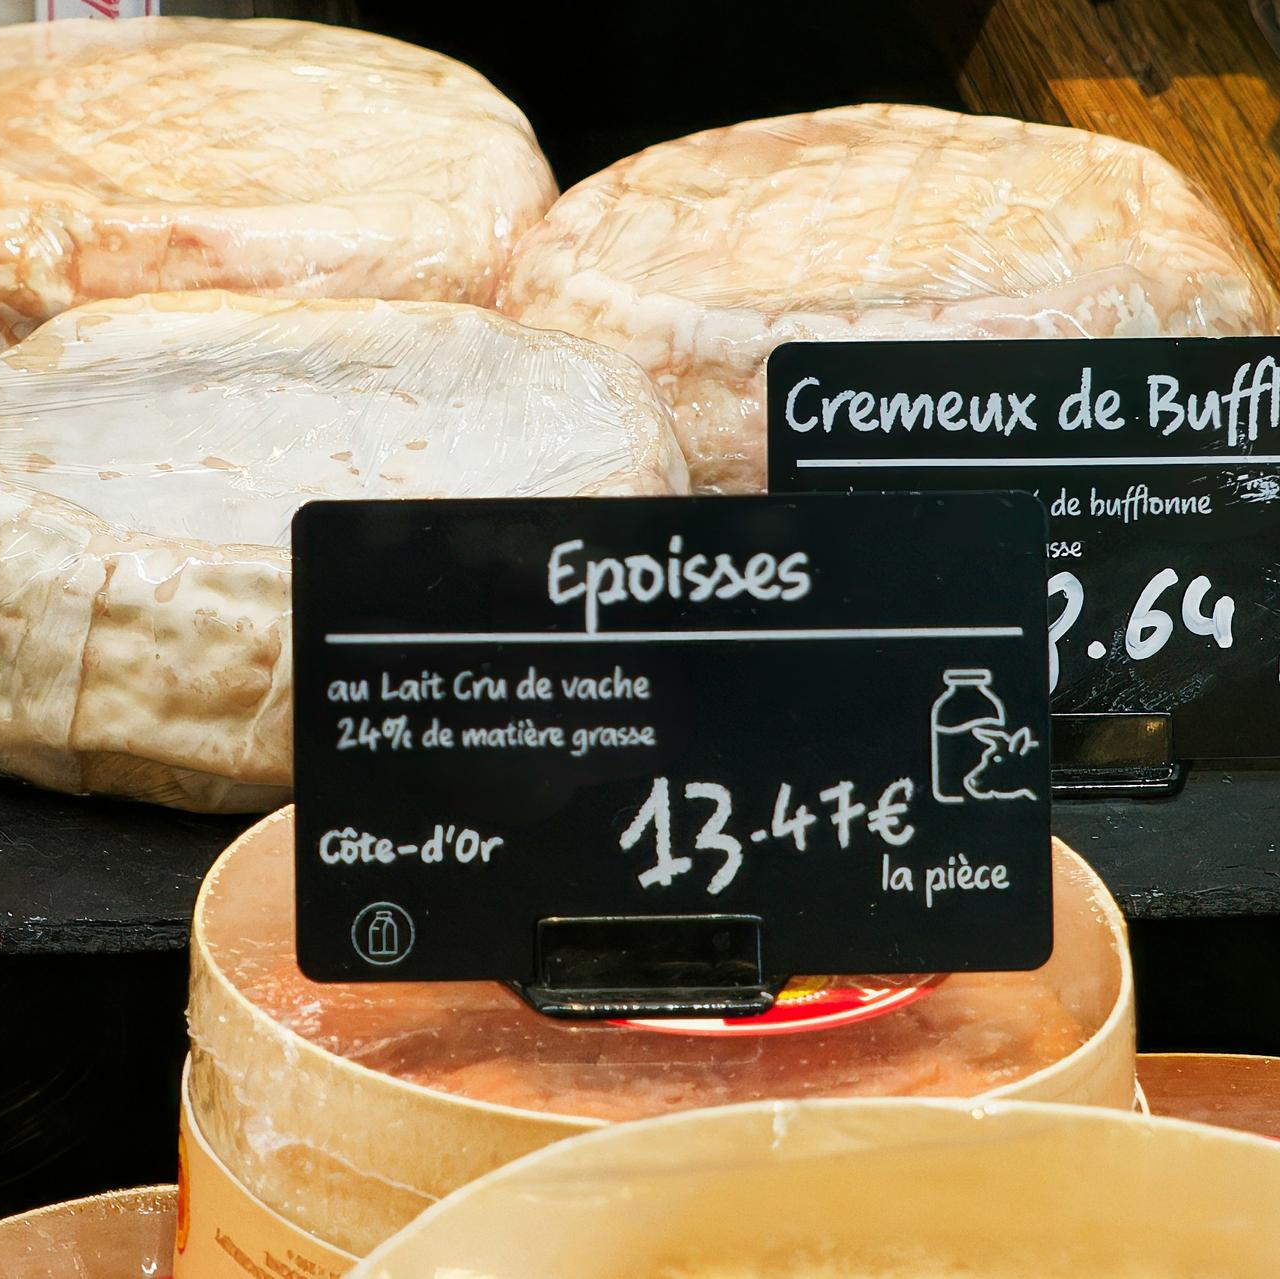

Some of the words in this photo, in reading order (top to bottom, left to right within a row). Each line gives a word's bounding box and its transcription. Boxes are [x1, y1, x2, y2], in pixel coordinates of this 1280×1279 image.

[784, 376, 1037, 436] Cremeux
[1058, 366, 1126, 430] de
[1051, 488, 1082, 517] de
[1090, 484, 1213, 523] bufflonne
[547, 534, 812, 634] Epoisses
[328, 676, 370, 703] au
[381, 670, 445, 702] Lait
[454, 670, 507, 702] Cru
[518, 668, 553, 701] de
[562, 668, 649, 701] vache
[337, 716, 413, 752] 24%
[422, 718, 454, 749] de
[461, 720, 564, 750] matière
[571, 723, 655, 756] grasse
[319, 824, 503, 866] Côte-d'Or
[620, 775, 916, 895] 13.47€
[882, 853, 914, 892] la
[925, 853, 1010, 907] pièce
